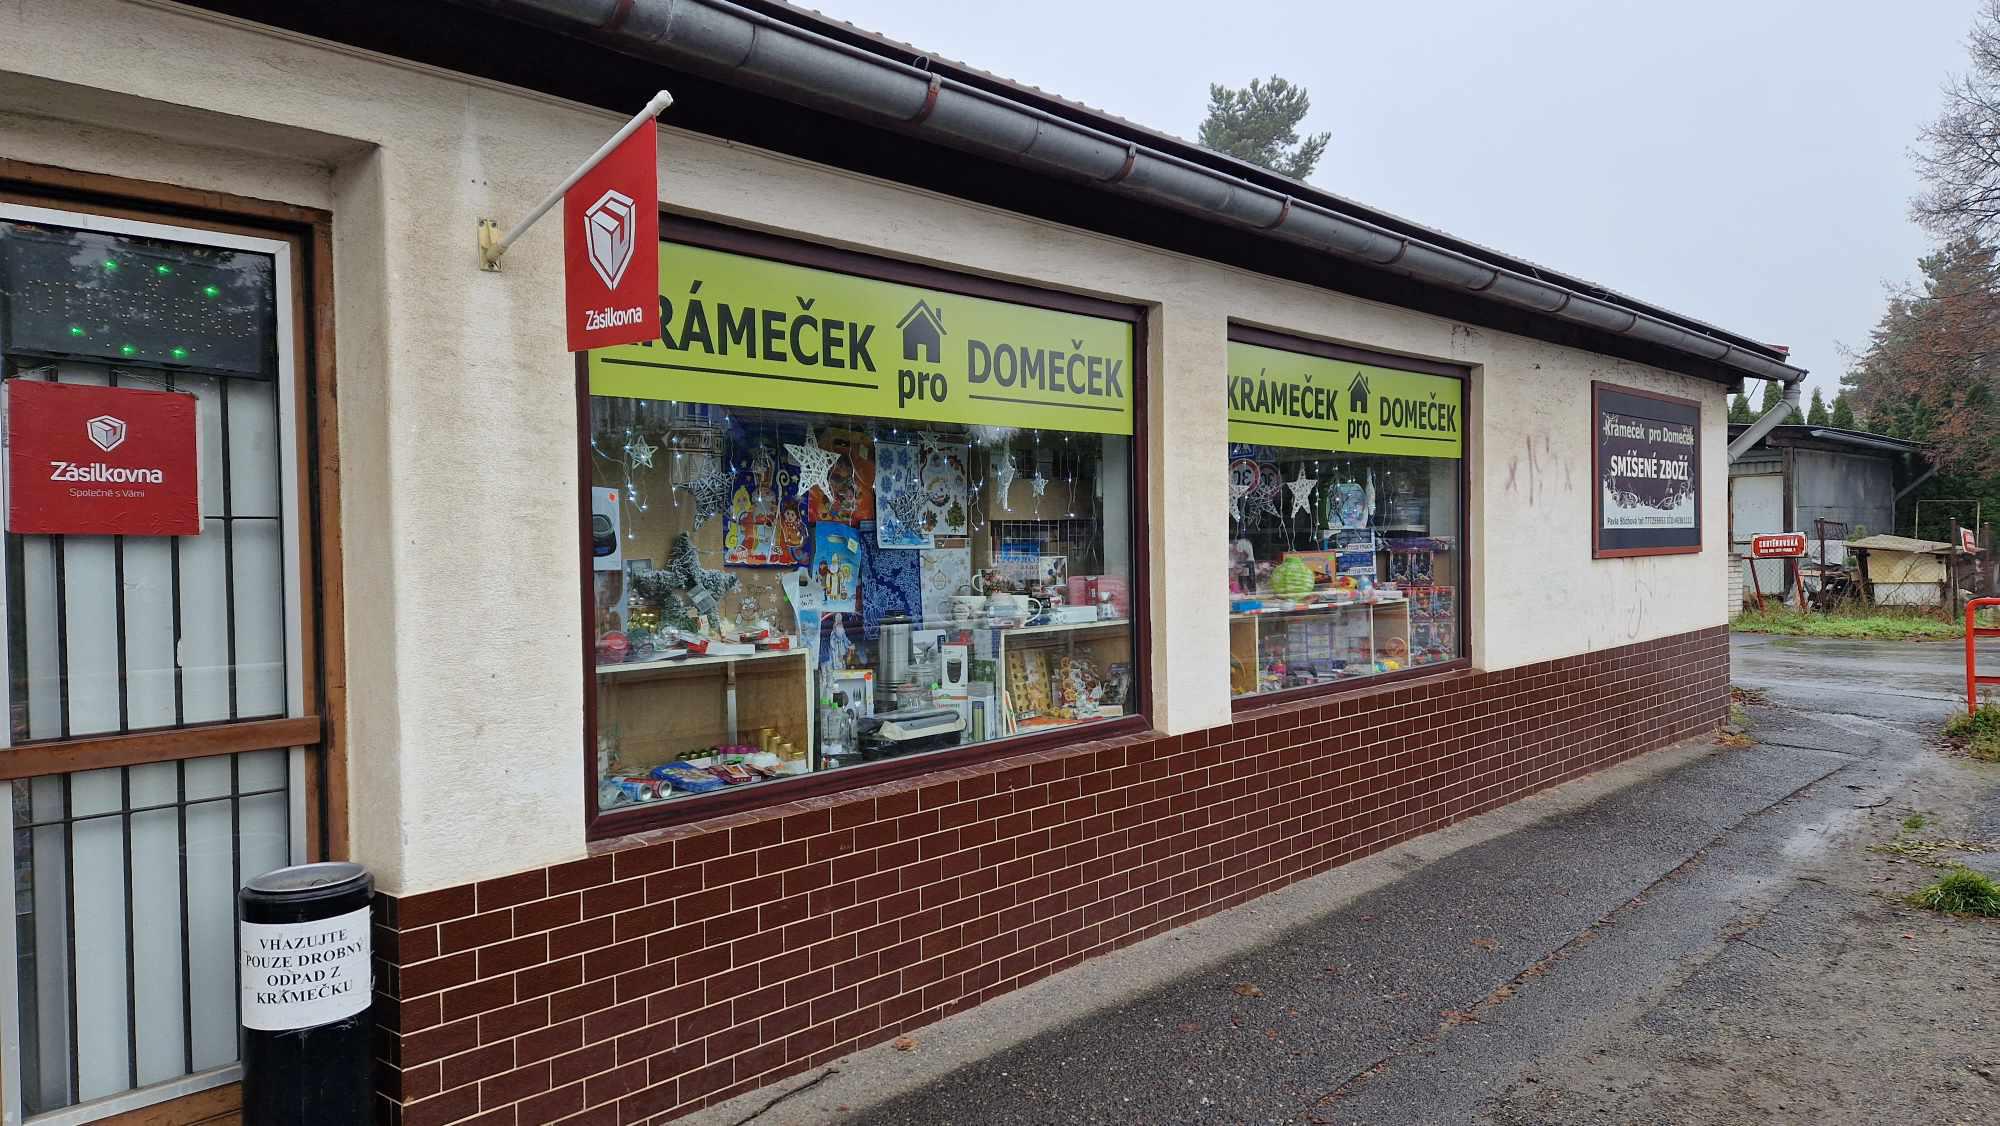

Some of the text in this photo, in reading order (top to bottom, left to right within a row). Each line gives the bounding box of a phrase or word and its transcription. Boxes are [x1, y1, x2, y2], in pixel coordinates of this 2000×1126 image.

[585, 306, 643, 331] Zásilkovna
[898, 369, 948, 409] pro
[967, 339, 1124, 399] DOMEČEK
[1227, 367, 1457, 445] KRÁMEČEK pro DOMEČEK
[1604, 420, 1695, 446] Krámeček pro Domeček
[50, 461, 163, 484] Zásilkovna
[1610, 449, 1689, 481] SMÍŠENÉ ZBOŽÍ
[69, 488, 114, 499] Společně
[121, 488, 145, 498] Vámi
[260, 928, 348, 951] VHAZUJTE
[246, 954, 293, 968] POUZE
[267, 966, 342, 986] ODPAD Z
[257, 979, 353, 1005] KRÁMEČKU
